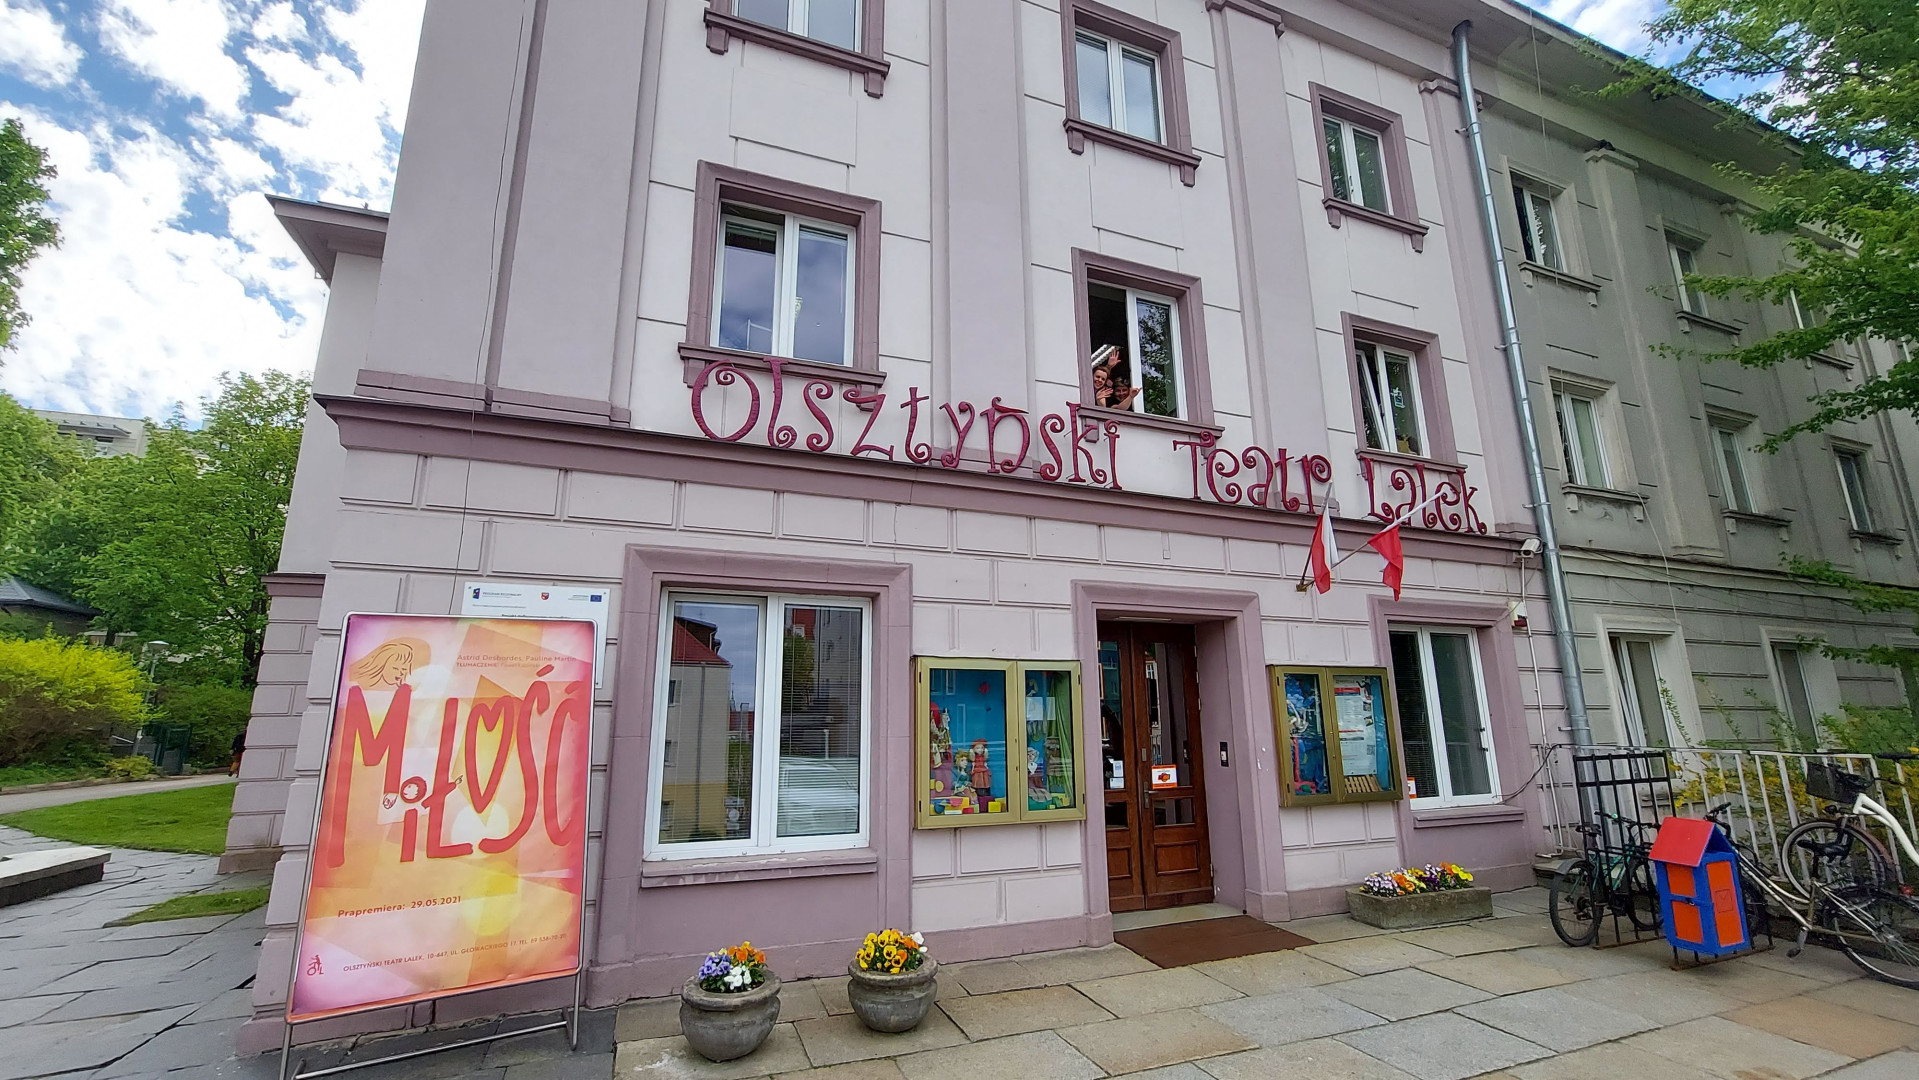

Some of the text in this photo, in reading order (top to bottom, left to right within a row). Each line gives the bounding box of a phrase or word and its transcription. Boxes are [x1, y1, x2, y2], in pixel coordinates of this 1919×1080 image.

[691, 356, 1488, 535] Olsztyński Teatr Lalek
[337, 895, 462, 918] Prapremiera: 29.05.2021
[343, 961, 382, 972] OLSZTYŃSKI
[384, 958, 402, 966] TEATR
